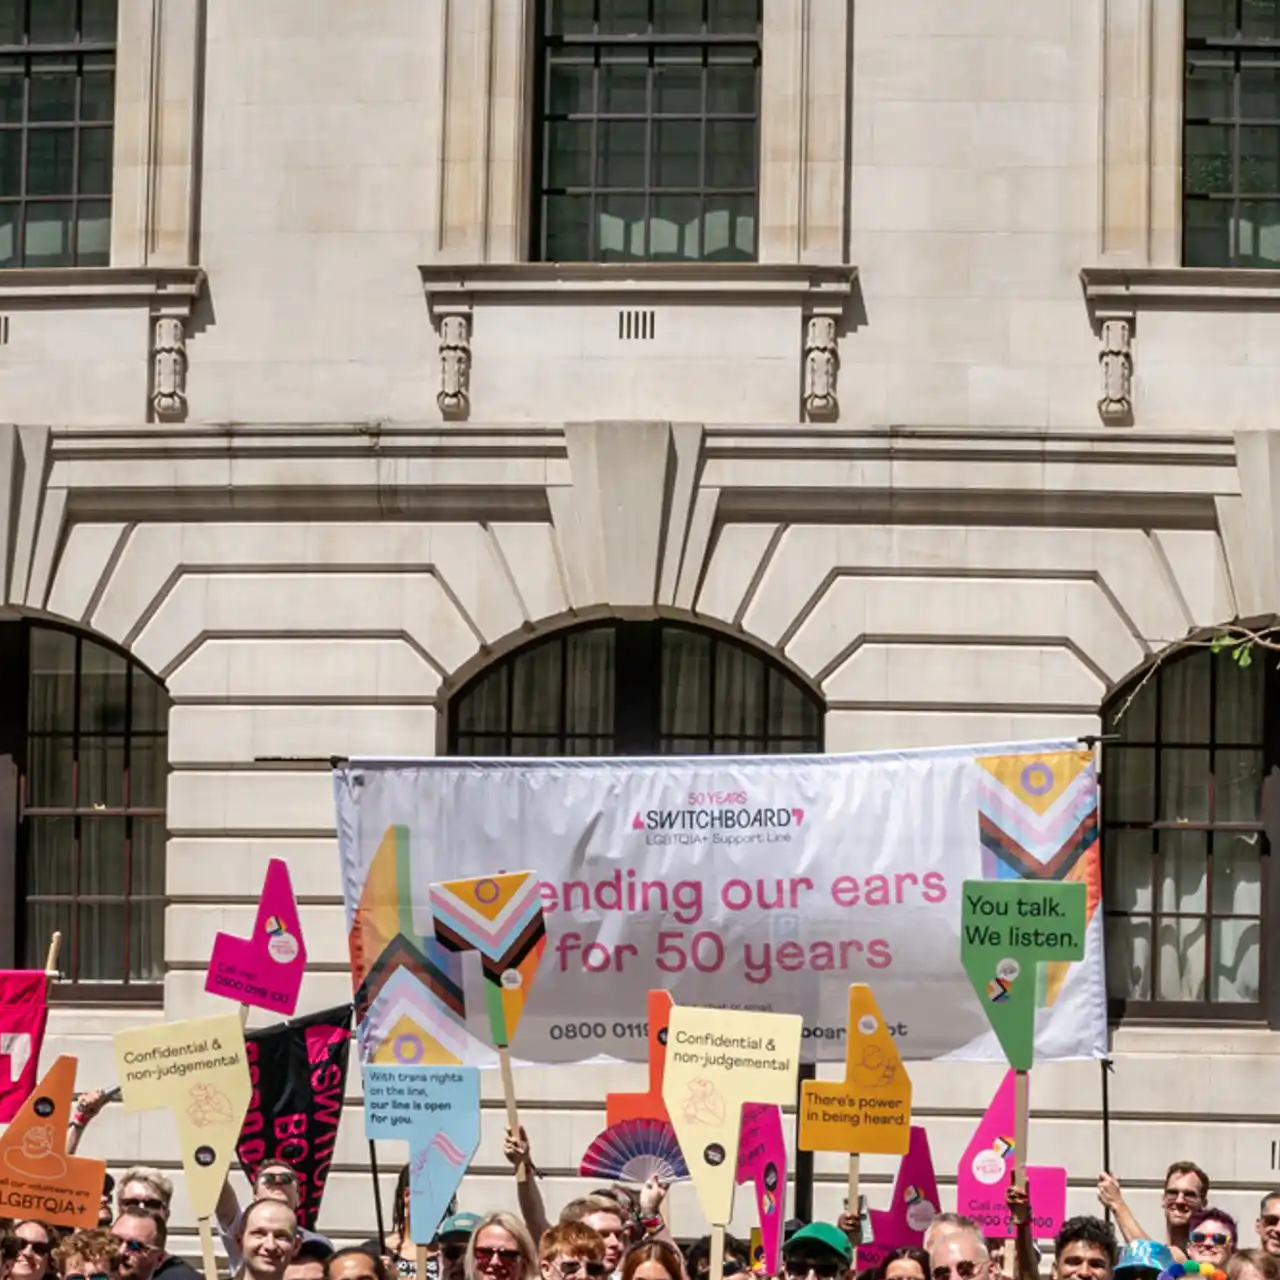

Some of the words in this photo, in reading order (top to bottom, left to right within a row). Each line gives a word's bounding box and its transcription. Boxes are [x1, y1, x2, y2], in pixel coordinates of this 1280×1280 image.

[707, 791, 747, 805] YEARS
[646, 807, 791, 832] SWITCHBOARD
[713, 833, 761, 845] Support
[767, 832, 792, 843] Line
[538, 869, 702, 926] ending
[721, 873, 814, 911] our
[831, 870, 948, 908] ears
[967, 895, 1008, 916] You
[1017, 897, 1065, 917] talk.
[965, 925, 1000, 946] We
[1008, 926, 1078, 948] listen.
[555, 931, 638, 974] for
[655, 931, 725, 974] 50
[744, 938, 893, 984] years
[549, 1023, 606, 1041] 0800
[676, 1031, 762, 1049] Confidential
[765, 1039, 775, 1051] &
[123, 1041, 208, 1065] Confidential
[212, 1038, 222, 1050] &
[674, 1051, 790, 1071] non-judgemental
[127, 1052, 239, 1082] non-judgemental
[370, 1071, 395, 1082] With
[398, 1072, 427, 1082] trans
[430, 1071, 463, 1085] rights
[370, 1088, 383, 1096] on
[386, 1086, 405, 1096] the
[807, 1092, 855, 1106] There's
[859, 1097, 902, 1109] power
[370, 1101, 389, 1110] our
[392, 1099, 409, 1110] line
[413, 1099, 422, 1110] is
[424, 1101, 451, 1113] open
[370, 1114, 388, 1124] for
[391, 1115, 412, 1126] you.
[807, 1110, 819, 1120] in
[822, 1110, 860, 1126] being
[864, 1111, 905, 1125] heard.
